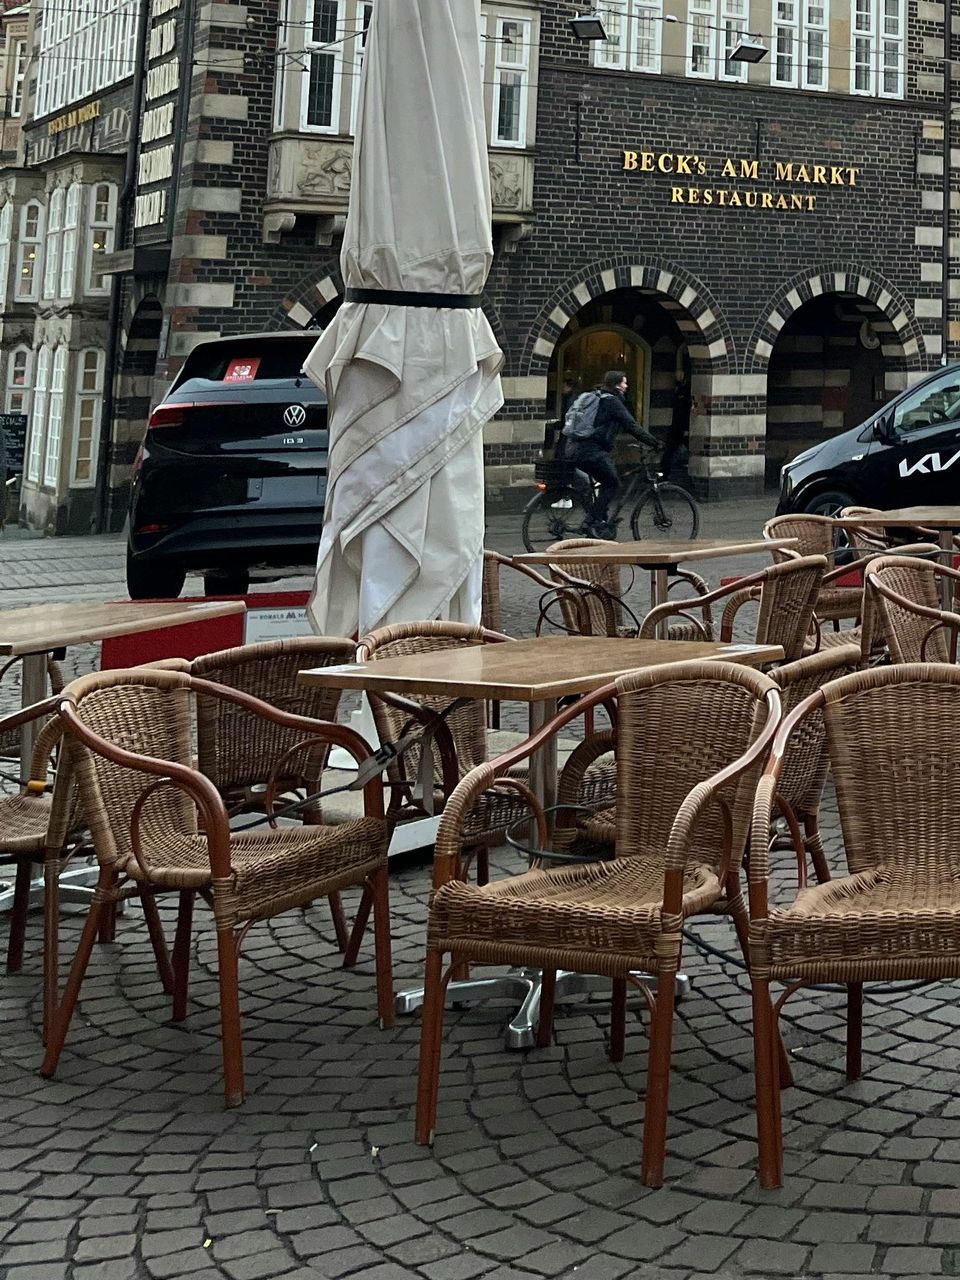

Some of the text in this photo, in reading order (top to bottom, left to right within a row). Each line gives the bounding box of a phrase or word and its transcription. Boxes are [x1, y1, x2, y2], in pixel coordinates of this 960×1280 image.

[721, 159, 759, 179] AM
[775, 162, 860, 186] MARKT
[670, 187, 817, 210] RESTAURANT
